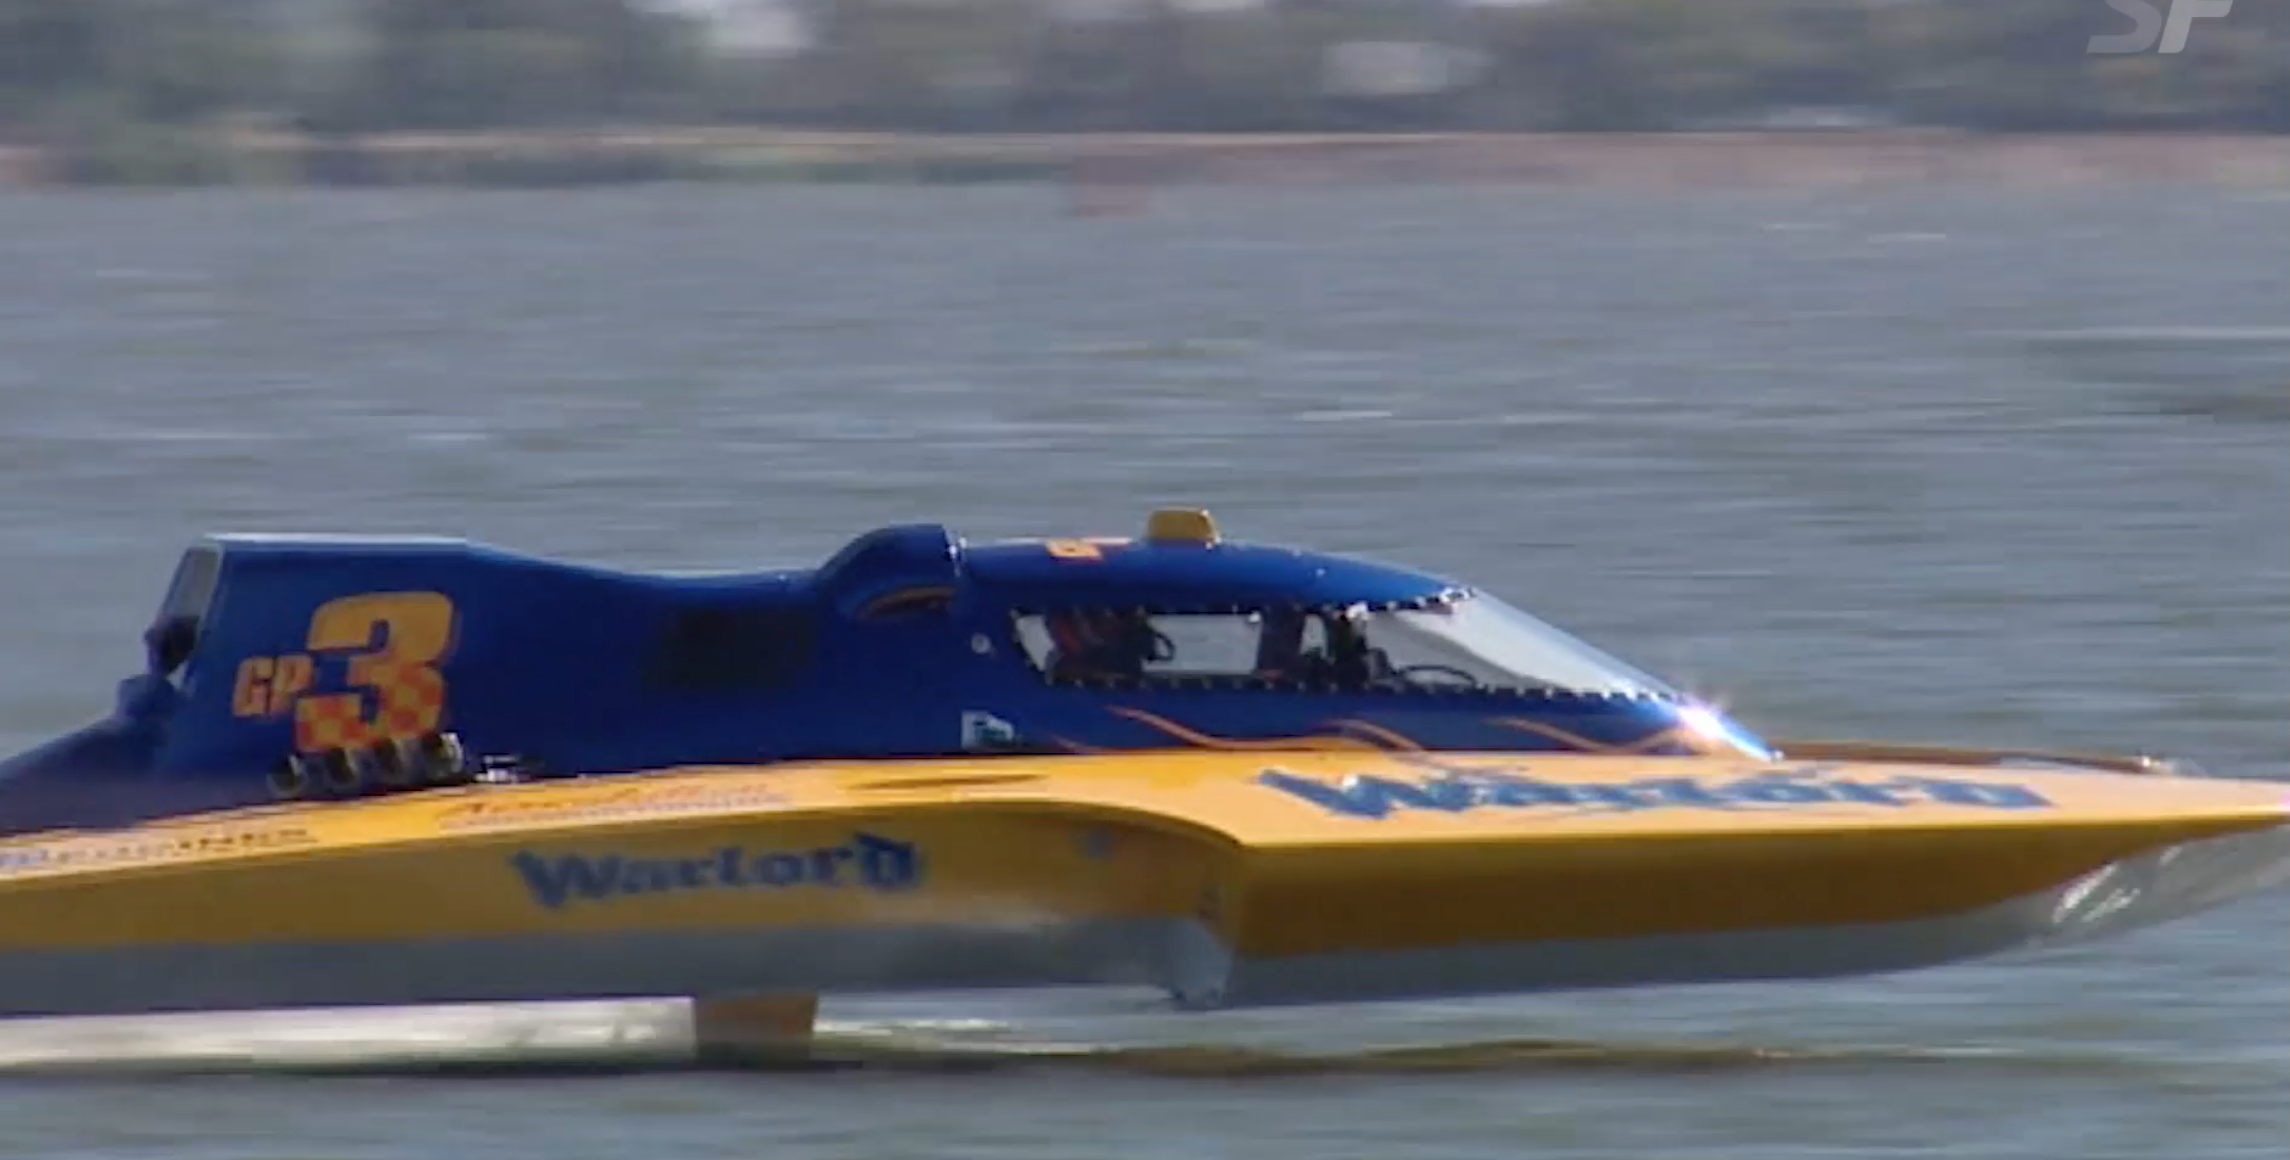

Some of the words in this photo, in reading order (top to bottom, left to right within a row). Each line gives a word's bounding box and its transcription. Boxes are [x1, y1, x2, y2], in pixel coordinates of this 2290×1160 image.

[233, 654, 313, 718] GP
[293, 590, 456, 754] 3
[510, 832, 918, 908] Warlord
